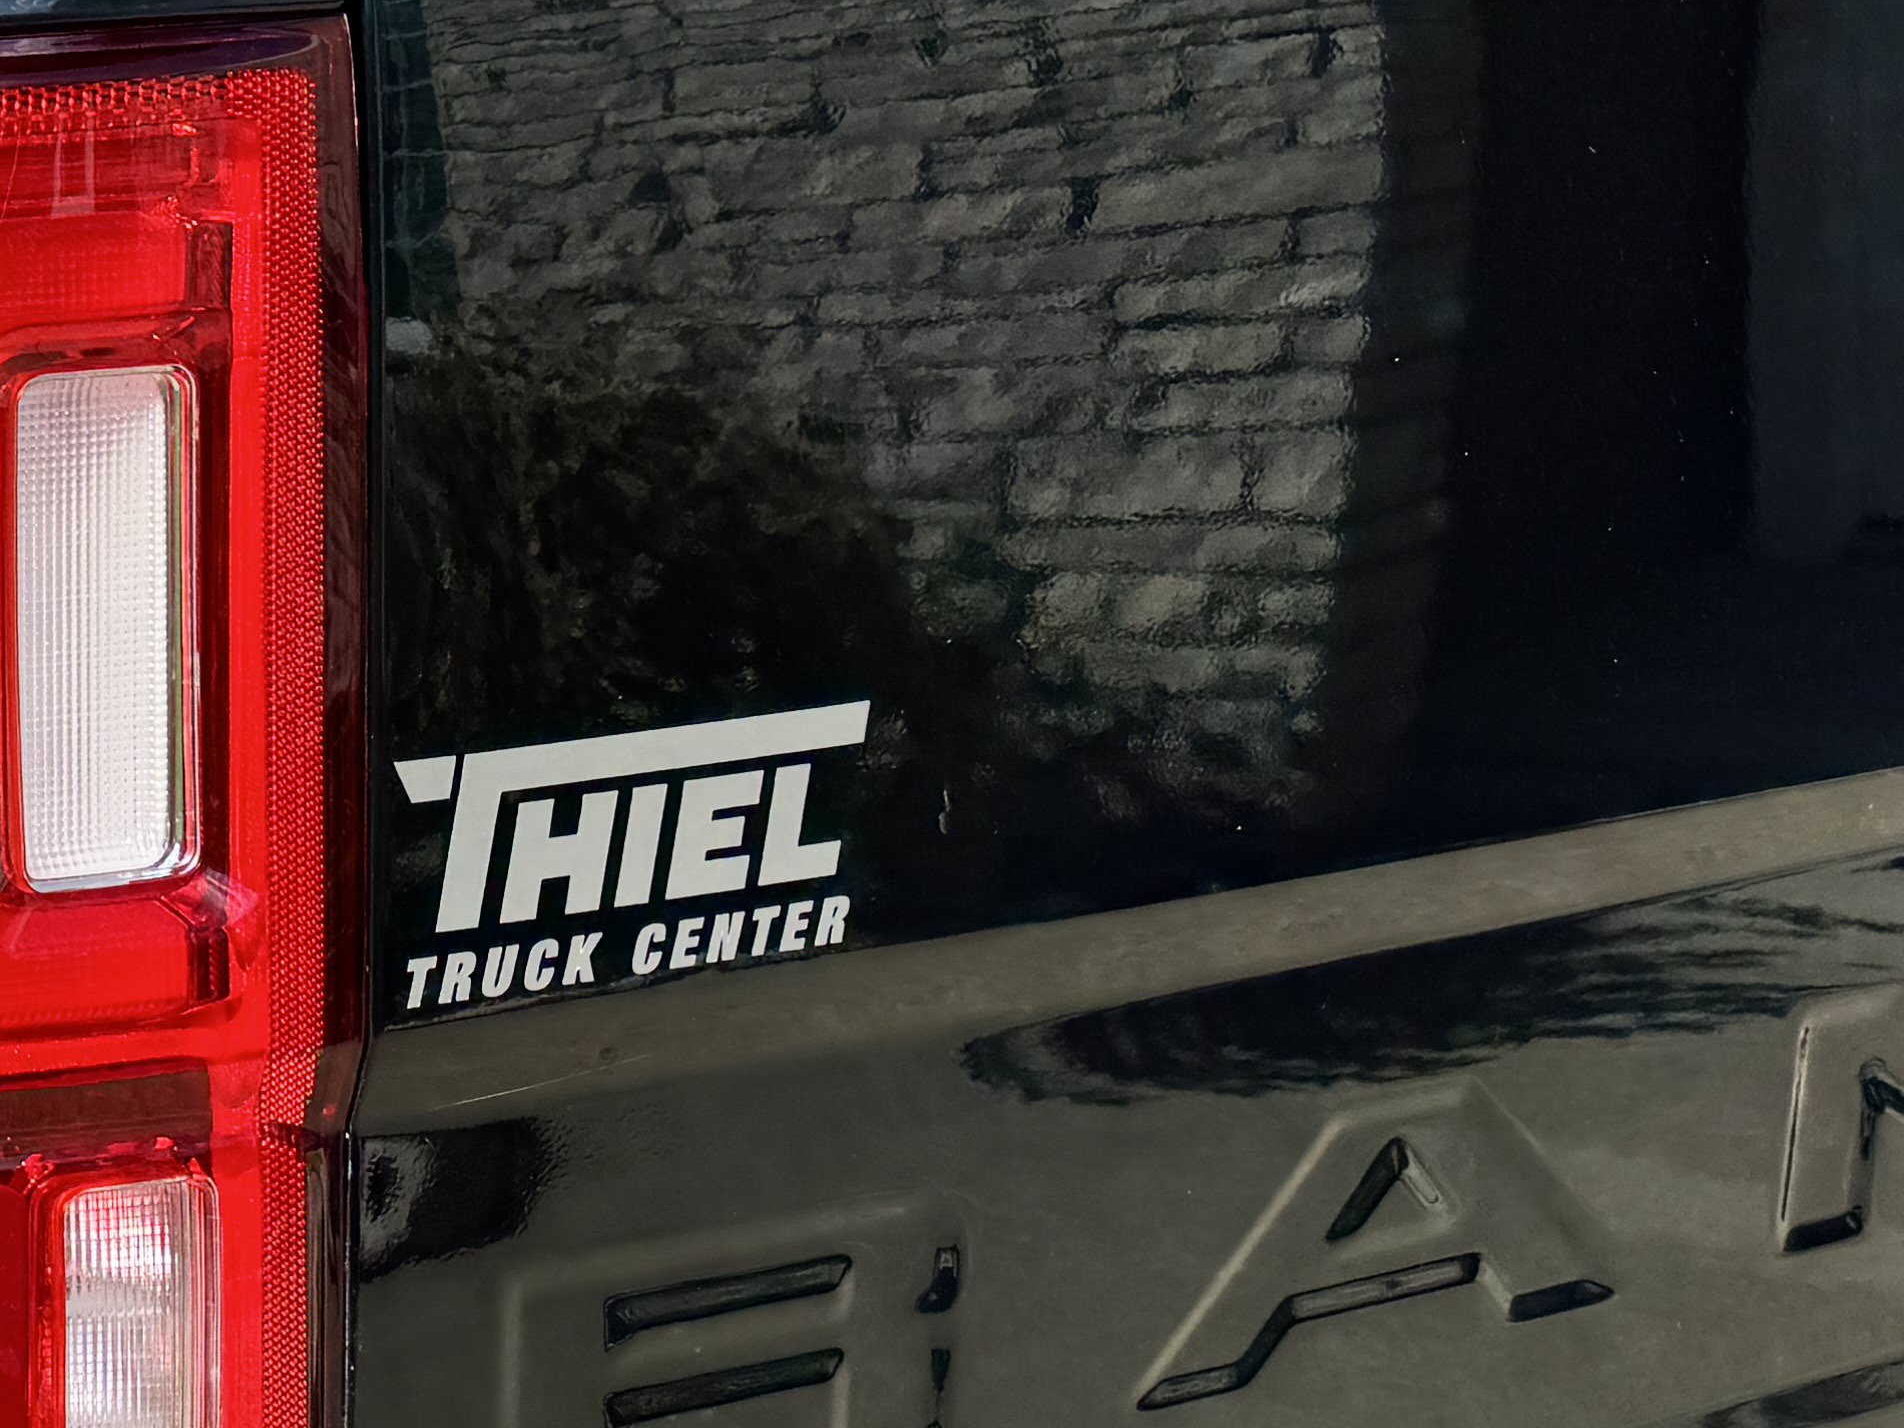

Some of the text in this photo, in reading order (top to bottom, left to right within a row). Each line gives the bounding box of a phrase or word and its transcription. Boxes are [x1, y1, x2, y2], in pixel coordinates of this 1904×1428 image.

[393, 699, 871, 934] THIEL
[405, 894, 851, 1011] TRUCK CENTER
